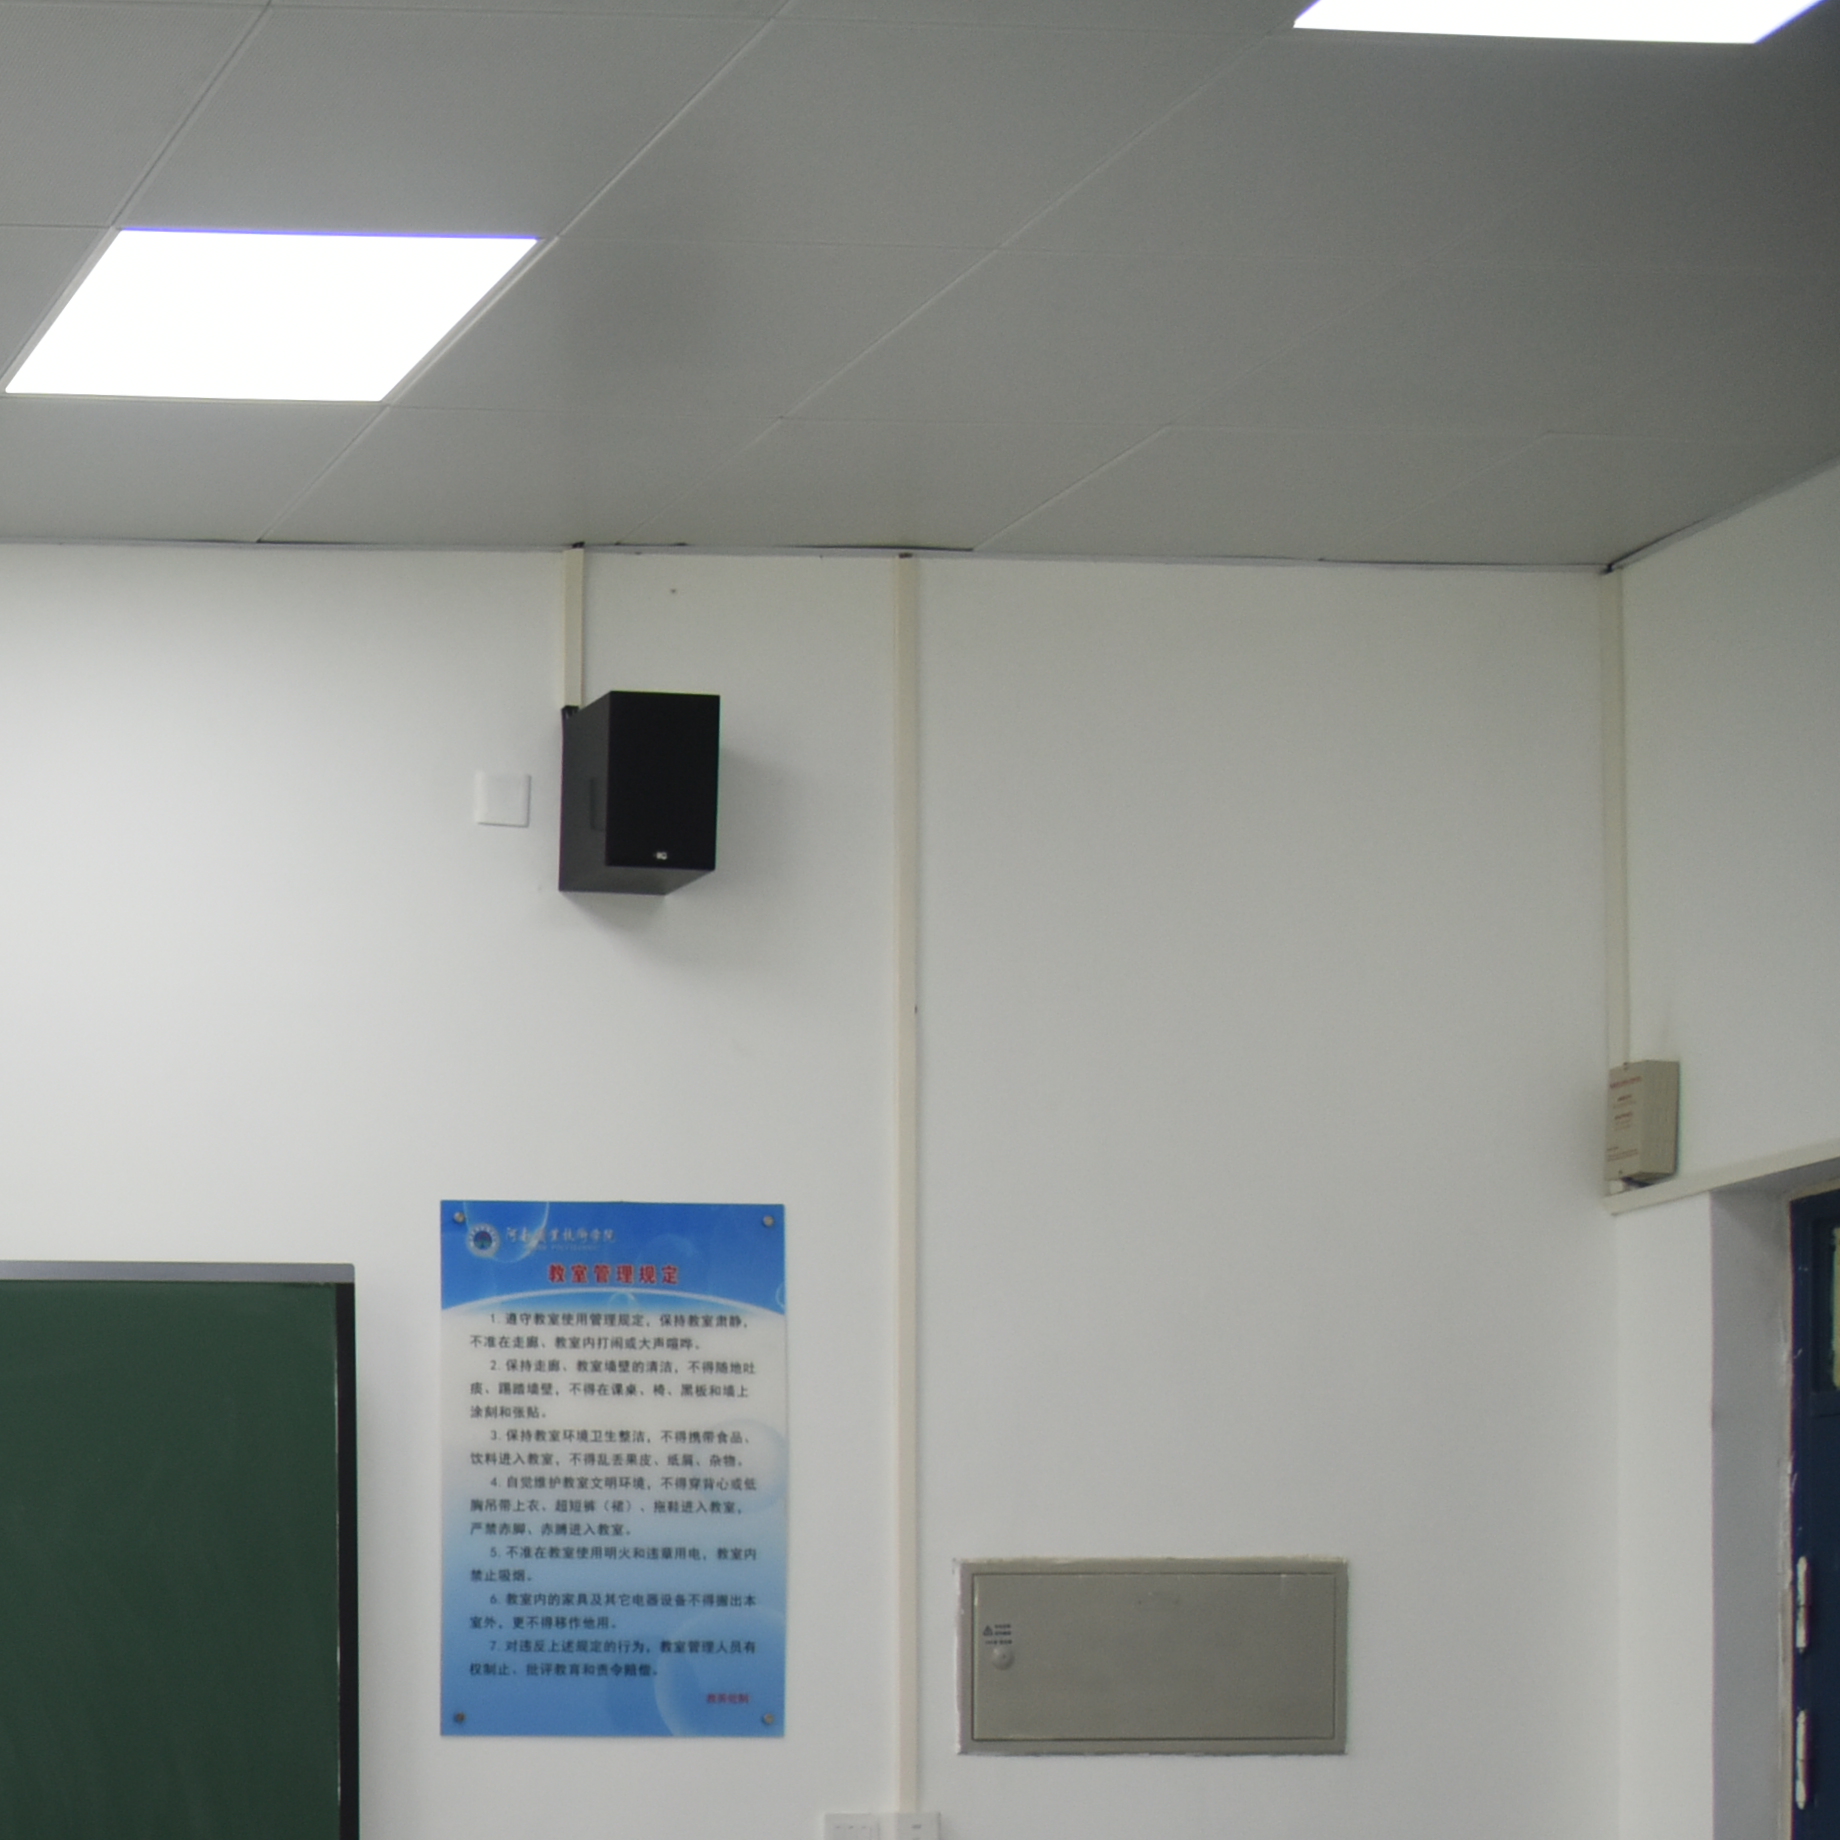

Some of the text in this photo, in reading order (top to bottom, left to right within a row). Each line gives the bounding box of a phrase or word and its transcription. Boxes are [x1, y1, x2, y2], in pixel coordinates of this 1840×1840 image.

[548, 1263, 680, 1285] 教室管理规定
[469, 1404, 547, 1419] 涂刻和张贴。
[470, 1568, 533, 1583] 禁止吸烟。
